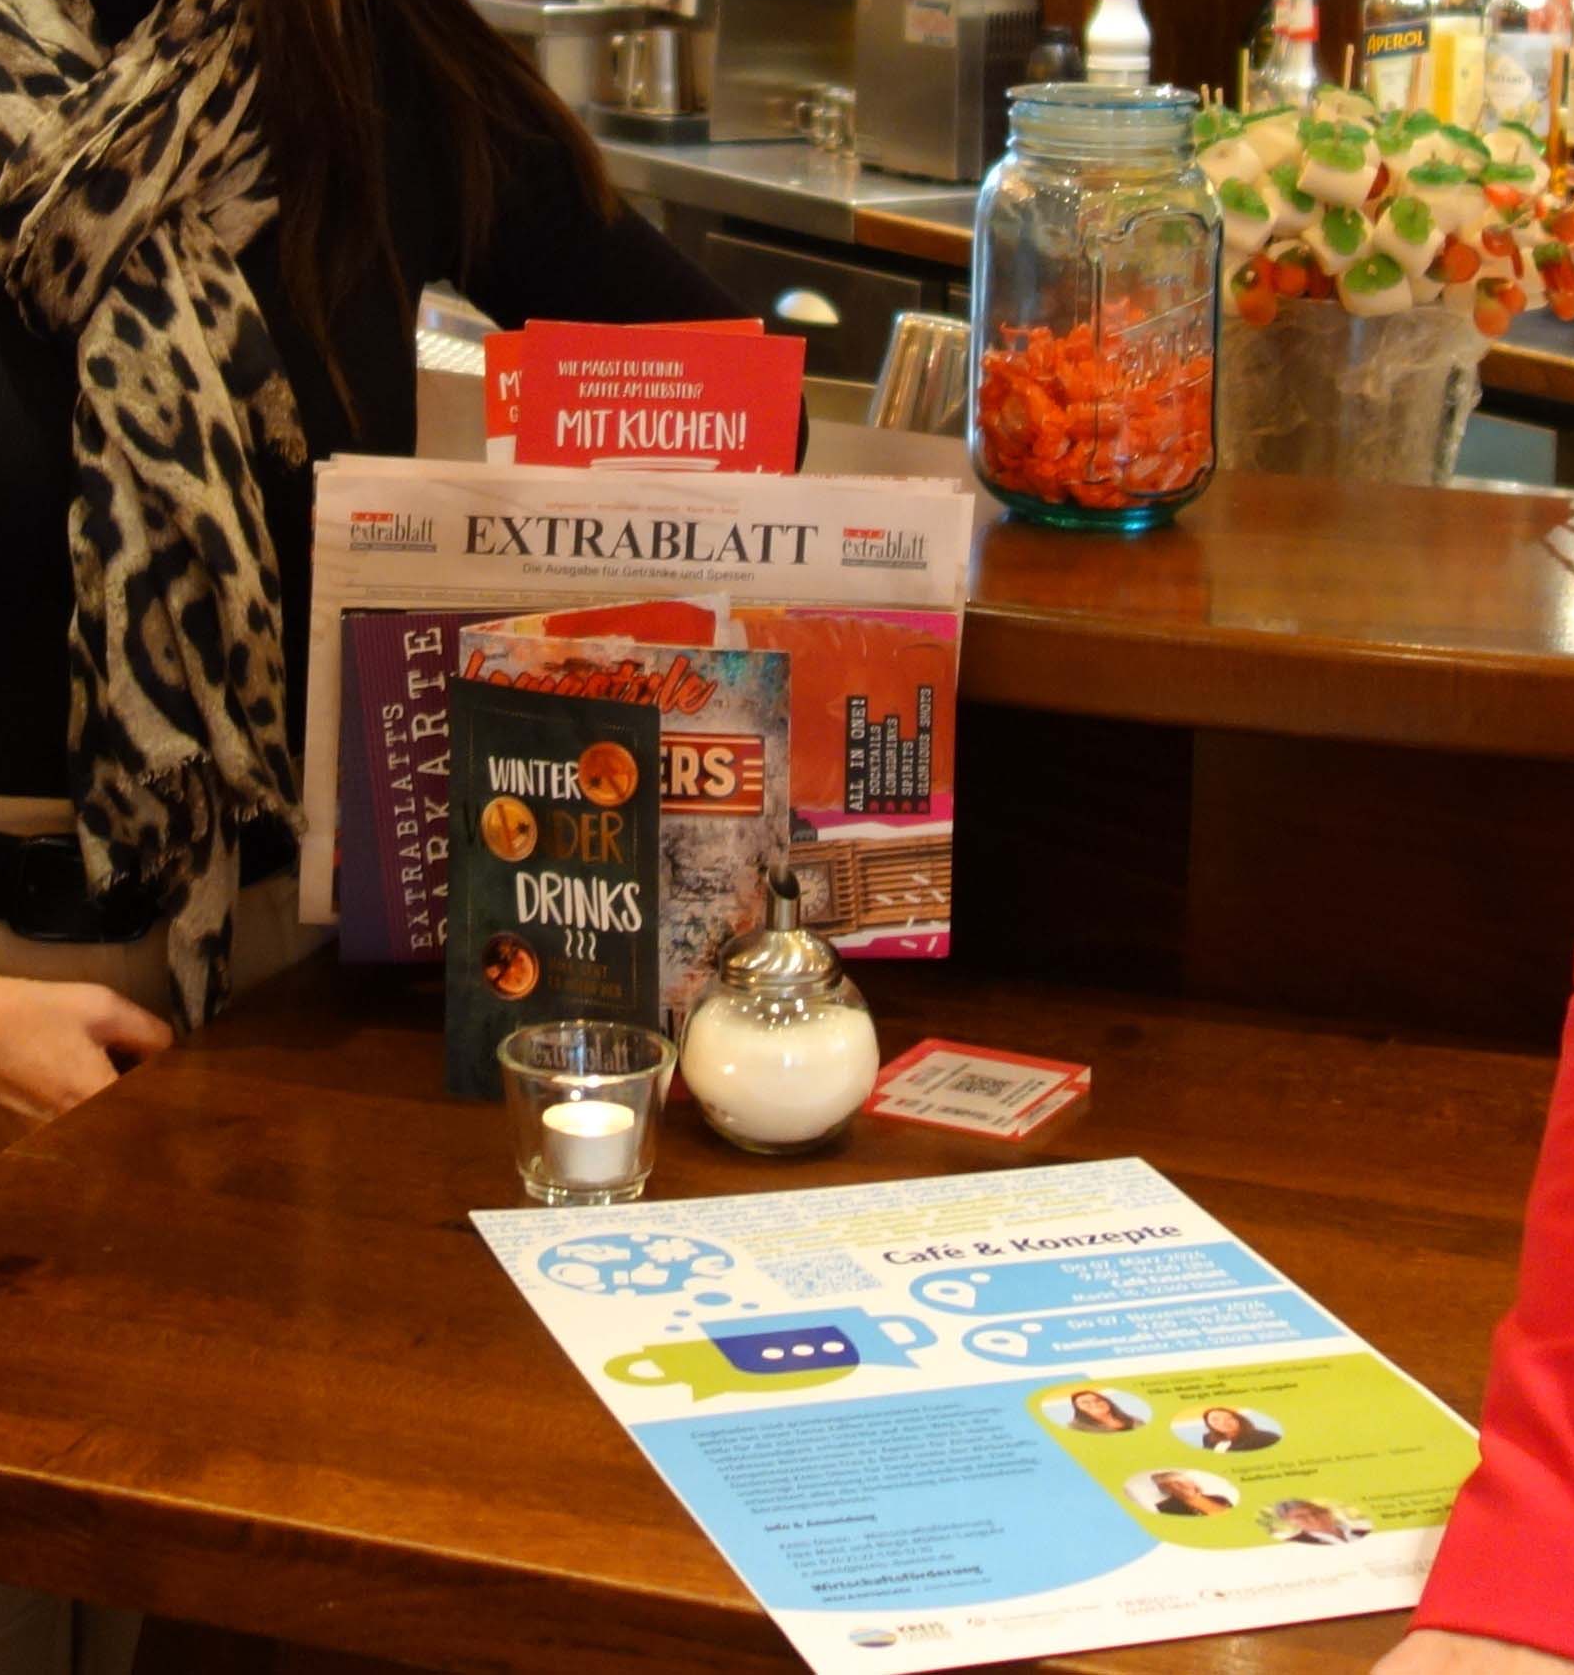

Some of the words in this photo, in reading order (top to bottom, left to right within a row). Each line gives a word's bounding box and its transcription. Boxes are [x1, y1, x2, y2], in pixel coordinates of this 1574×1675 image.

[1365, 27, 1425, 53] APEROL
[581, 359, 620, 378] MAGST
[623, 360, 639, 377] DU
[556, 409, 612, 449] MIT
[618, 409, 747, 451] KUCHEN!
[350, 513, 434, 543] extrablatt
[463, 514, 819, 565] EXTRABLATT
[842, 530, 925, 560] extrablatt
[522, 563, 543, 575] Die
[546, 563, 600, 579] Ausgabe
[602, 565, 620, 576] für
[622, 566, 677, 579] Getränke
[680, 568, 705, 580] und
[707, 568, 756, 583] Speisen
[850, 698, 866, 740] ONE!
[488, 755, 582, 801] WINTER
[850, 748, 865, 769] IN
[869, 725, 882, 796] COCKTAILS
[901, 741, 914, 796] SPIRITS
[849, 779, 864, 812] ALL
[383, 701, 434, 950] EXTRABLATT'S
[516, 871, 642, 932] DRINKS
[882, 1242, 967, 1266] Café
[977, 1240, 1004, 1258] &
[1010, 1223, 1183, 1254] Konzepte
